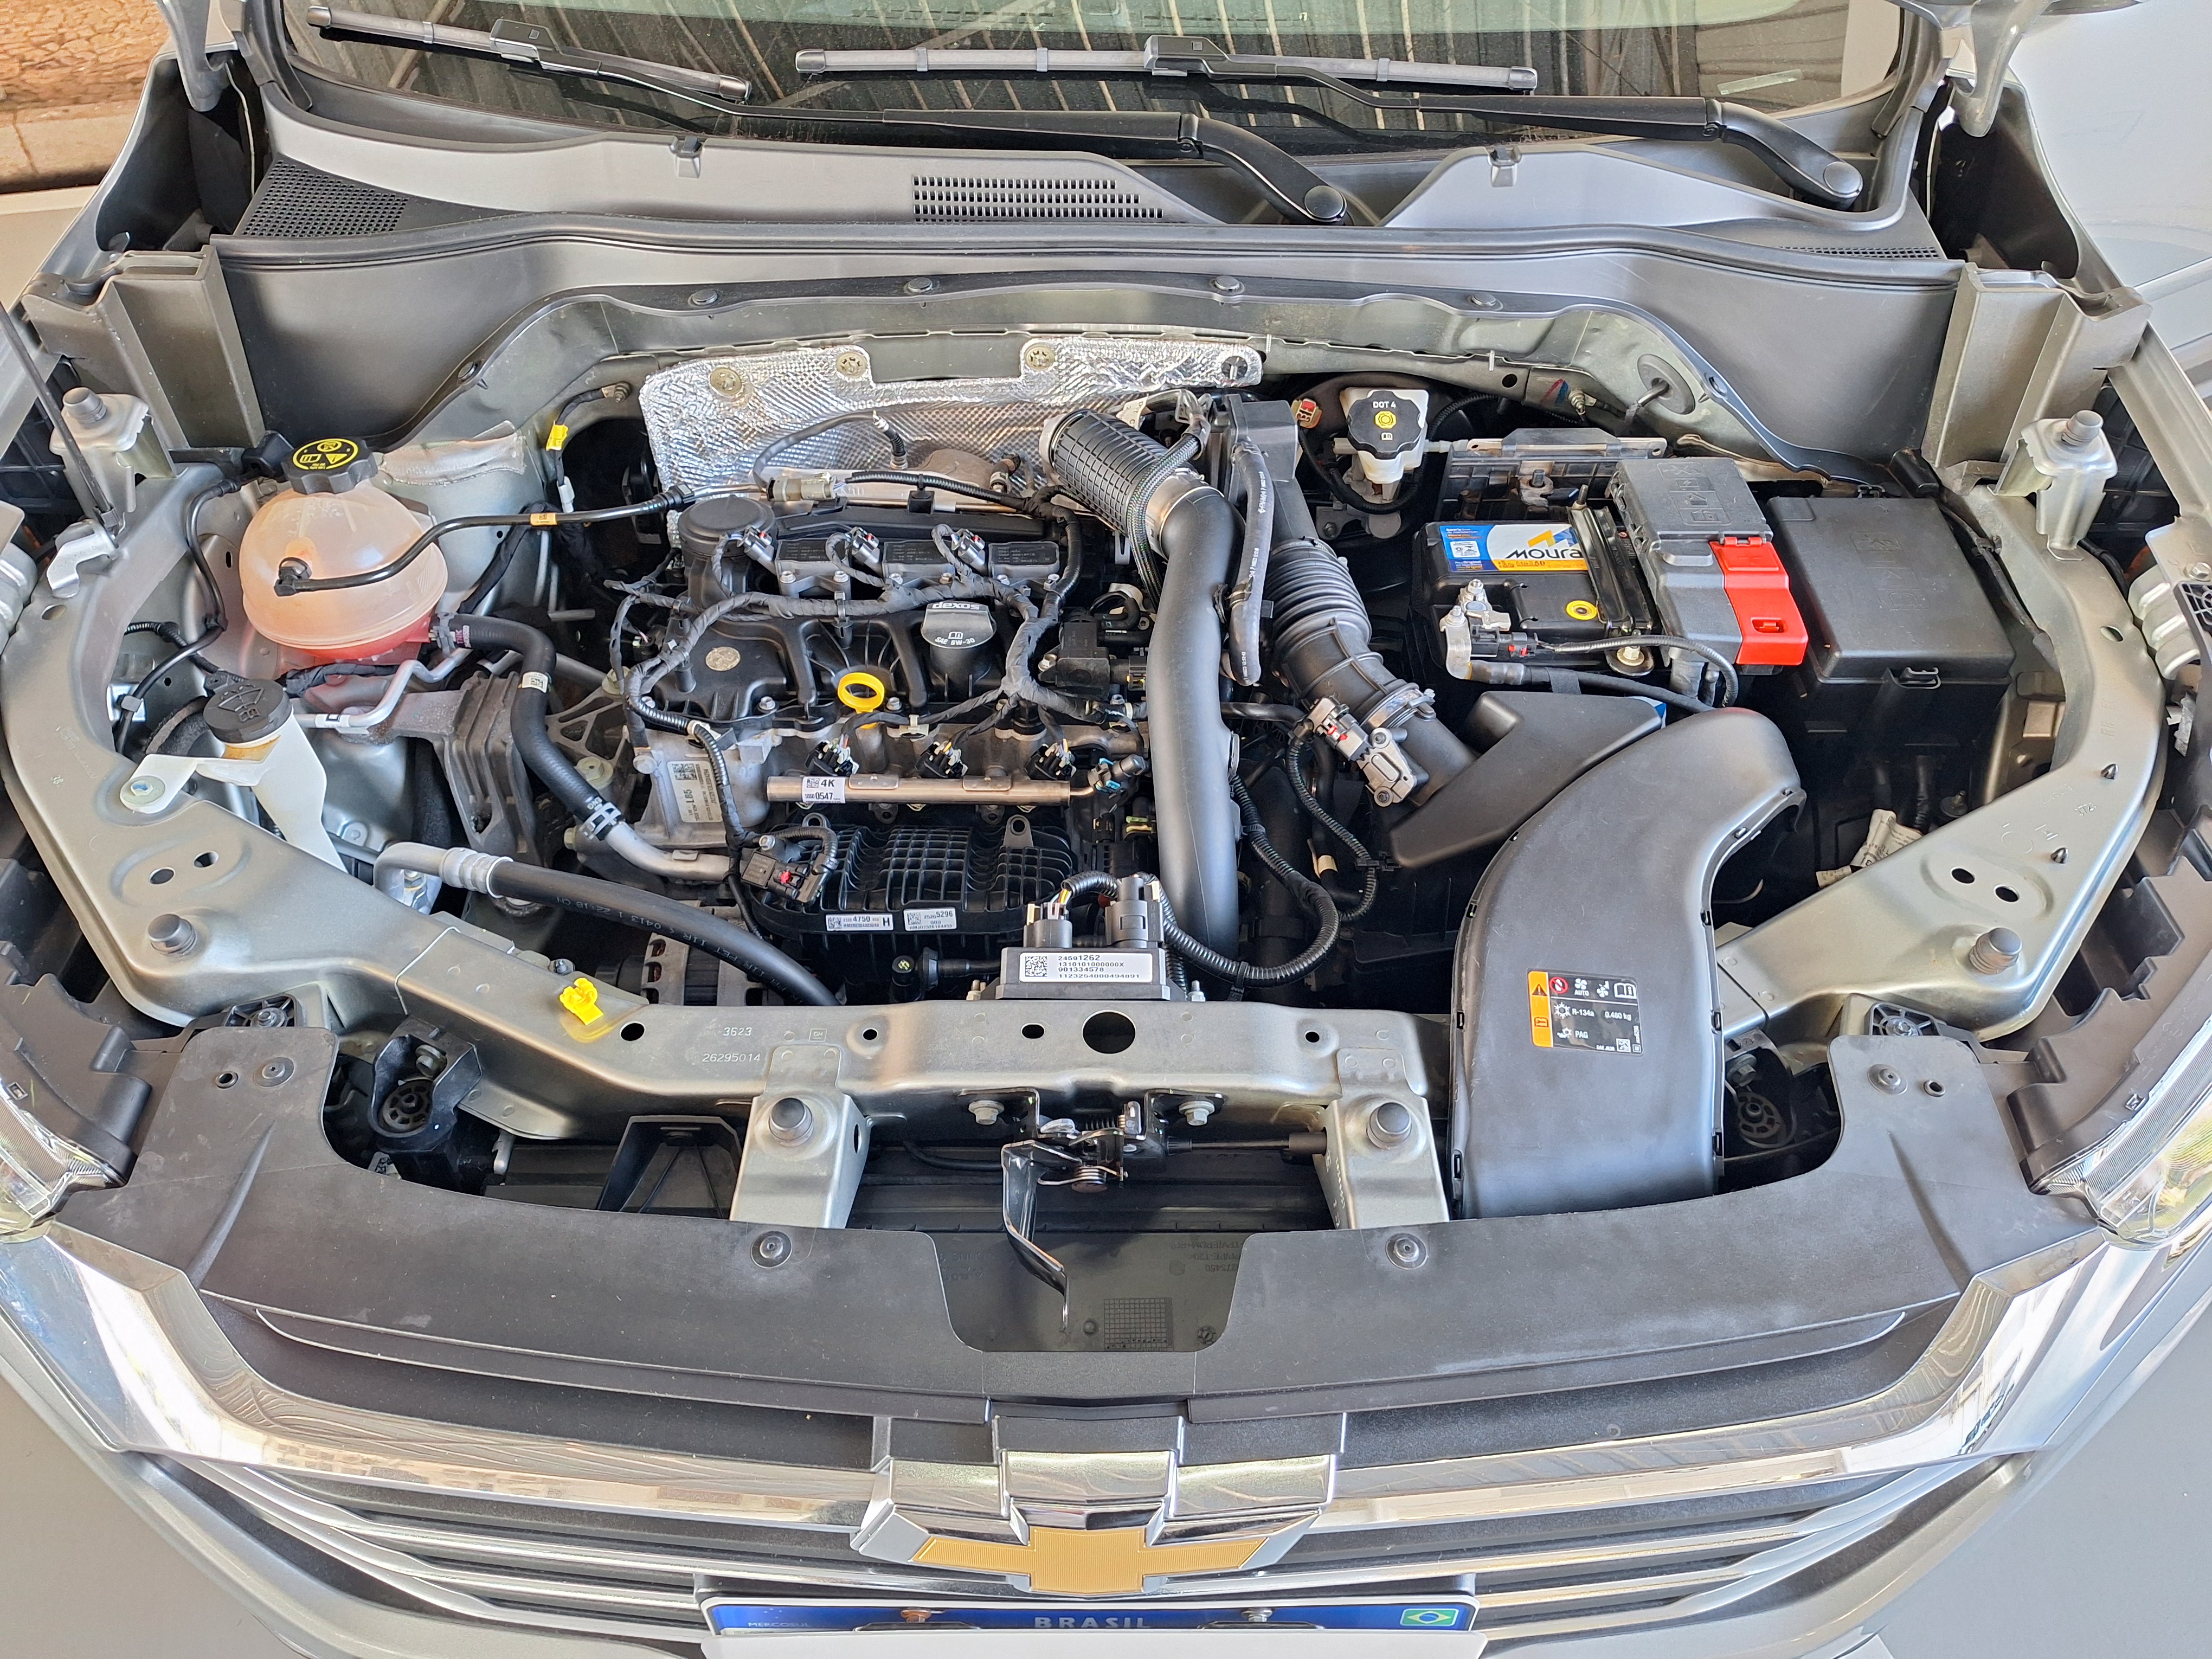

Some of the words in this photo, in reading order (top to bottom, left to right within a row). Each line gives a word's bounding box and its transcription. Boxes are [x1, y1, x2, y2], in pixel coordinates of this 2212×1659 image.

[932, 602, 980, 610] dexos
[935, 636, 949, 645] SAE
[950, 638, 975, 646] 5W-30
[821, 779, 835, 787] 4K
[883, 917, 890, 927] H
[1572, 1008, 1595, 1017] R-134a
[1605, 1011, 1622, 1019] 0.480
[1623, 1013, 1632, 1021] kg
[723, 1027, 753, 1036] 3623
[1574, 1031, 1589, 1039] PAG
[702, 1053, 761, 1063] 26295014
[1034, 1617, 1150, 1628] BRASIL
